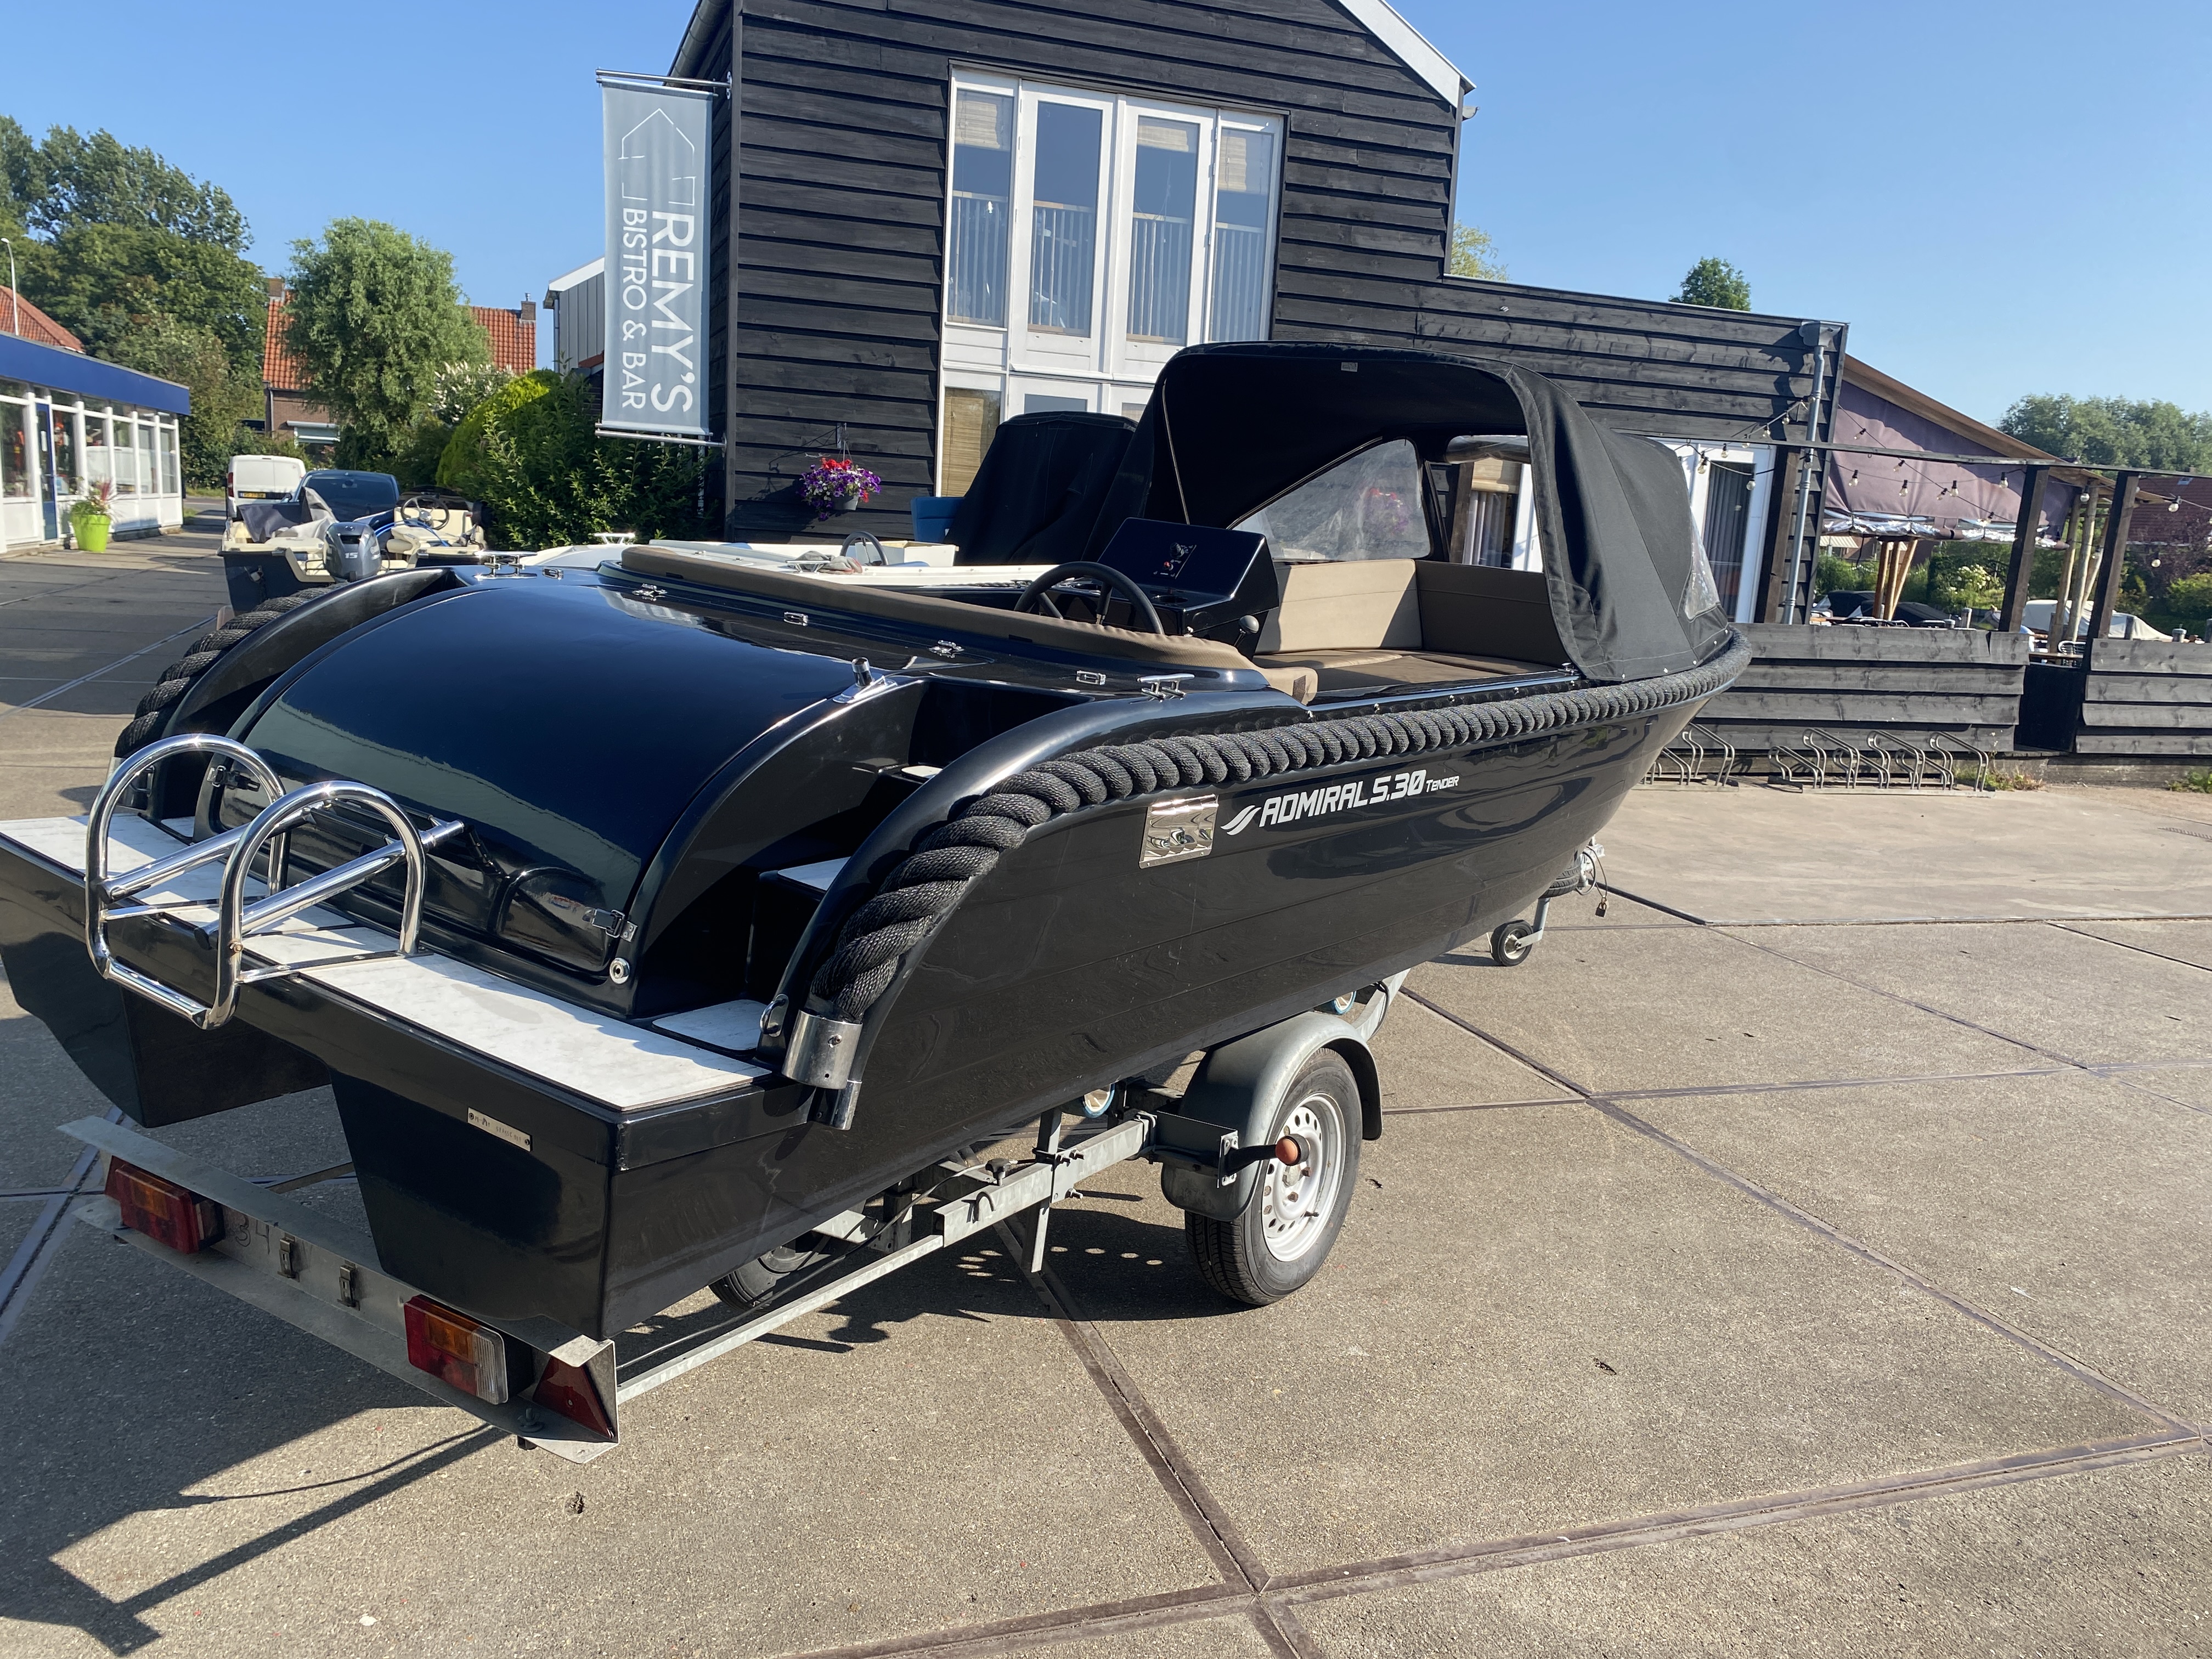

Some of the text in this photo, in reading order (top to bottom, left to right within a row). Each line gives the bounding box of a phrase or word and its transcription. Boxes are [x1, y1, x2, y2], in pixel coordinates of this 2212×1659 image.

[622, 208, 647, 409] BISTRO & BAR
[651, 211, 695, 413] REMY'S
[1259, 781, 1368, 827] ADMIRAL
[1369, 770, 1426, 804] 5.30
